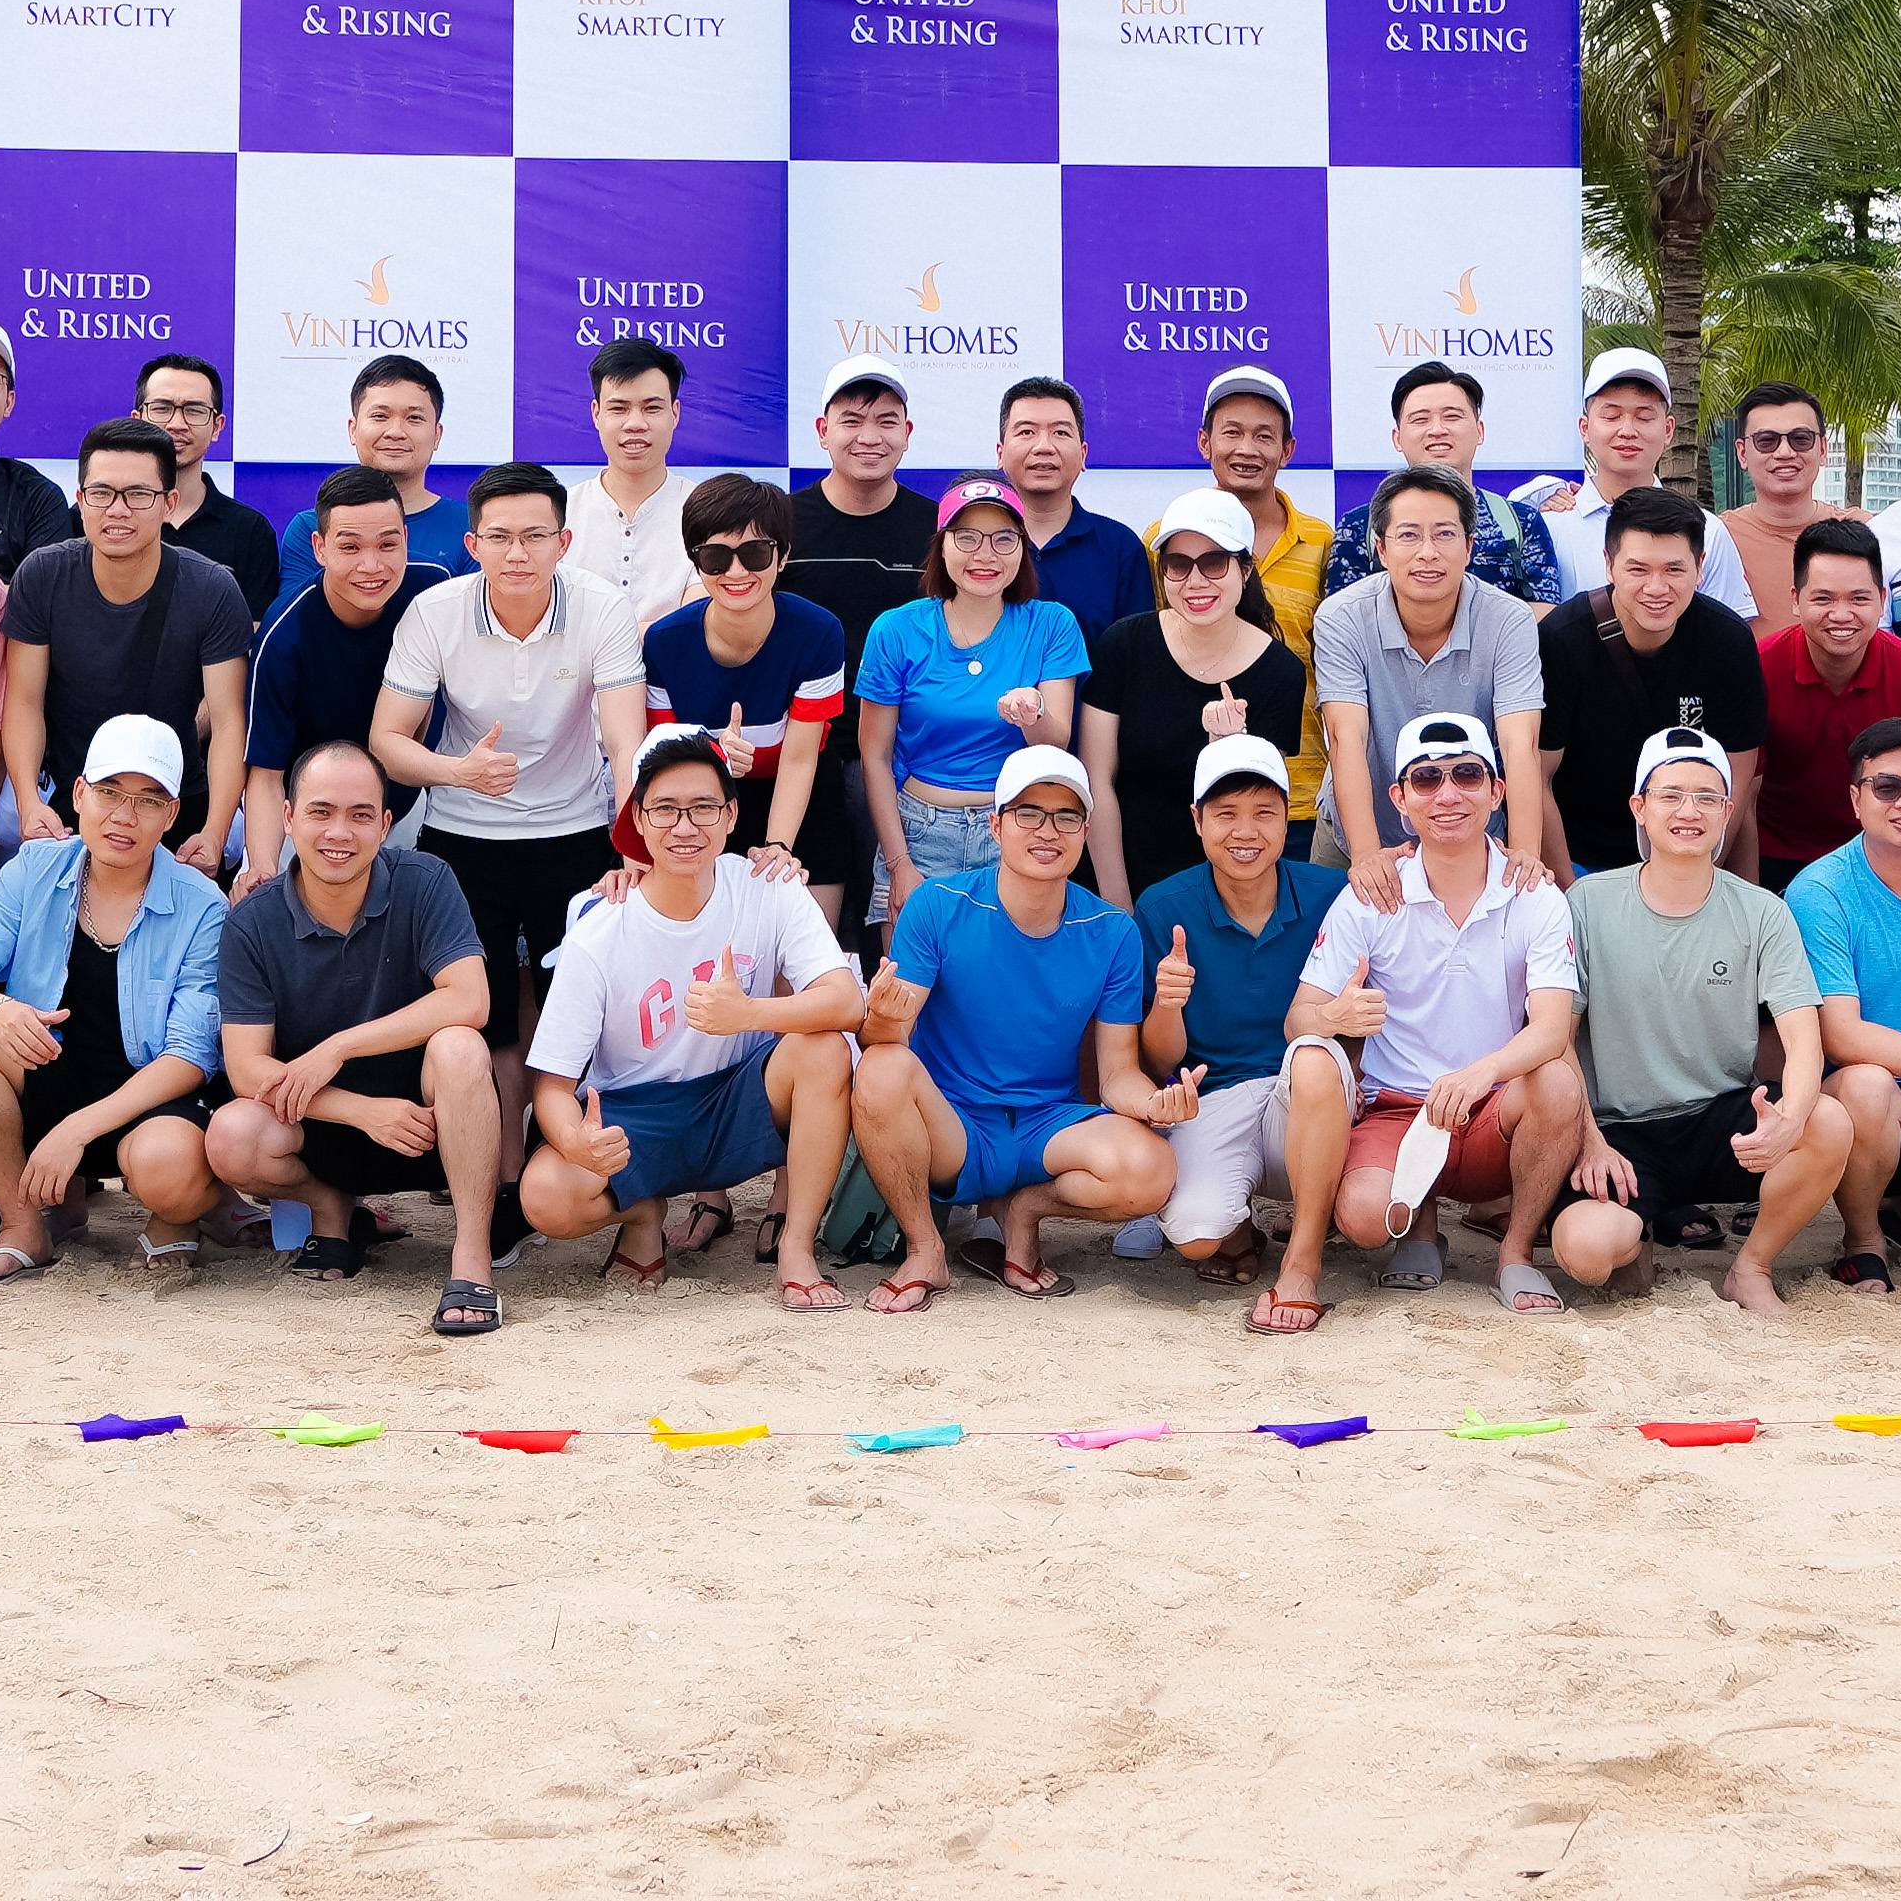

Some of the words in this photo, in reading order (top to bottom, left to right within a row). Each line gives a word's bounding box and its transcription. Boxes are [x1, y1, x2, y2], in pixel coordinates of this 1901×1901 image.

[302, 5, 331, 35] &
[337, 6, 453, 38] RISING
[850, 14, 879, 44] &
[884, 15, 998, 46] RISING
[1385, 22, 1413, 51] &
[1419, 23, 1529, 53] RISING
[22, 268, 151, 300] UNITED
[576, 277, 704, 308] UNITED
[1123, 282, 1248, 313] UNITED
[20, 308, 50, 338] &
[57, 309, 173, 341] RISING
[576, 316, 603, 347] &
[612, 317, 726, 348] RISING
[1123, 322, 1151, 351] &
[1157, 322, 1269, 352] RISING
